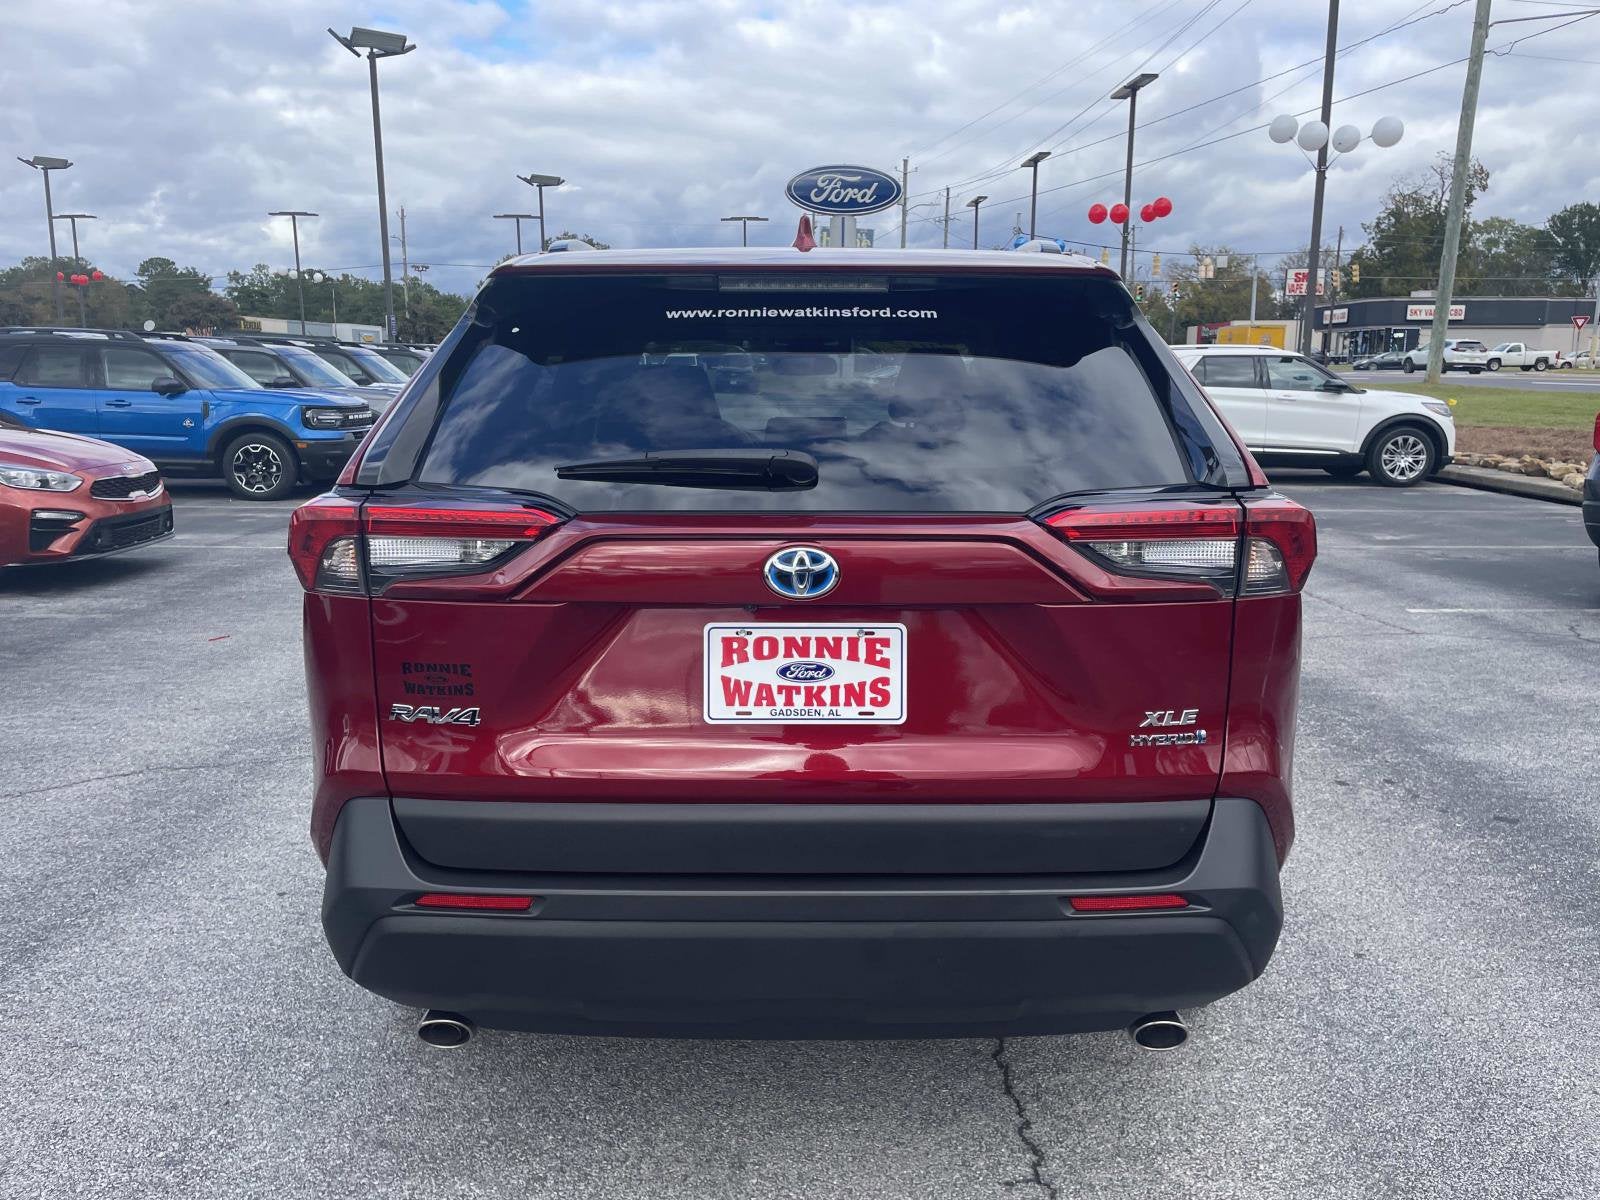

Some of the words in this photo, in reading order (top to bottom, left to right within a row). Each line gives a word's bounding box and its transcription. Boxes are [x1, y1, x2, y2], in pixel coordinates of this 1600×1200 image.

[810, 174, 878, 203] Ford
[1287, 283, 1304, 294] VAPE
[665, 306, 938, 319] www.ronniewatkinsford.com
[1409, 308, 1422, 317] SKY
[1449, 308, 1463, 317] CBD
[721, 636, 891, 669] RONNIE
[402, 662, 472, 677] RONNIE
[786, 663, 826, 679] Ford
[404, 681, 474, 696] WATKINS
[721, 675, 891, 708] WATKINS
[389, 703, 481, 727] RAV4
[770, 708, 825, 718] GADSDEN,
[828, 708, 842, 717] AL
[1139, 708, 1199, 728] XLE
[1130, 732, 1195, 747] HYBRID
